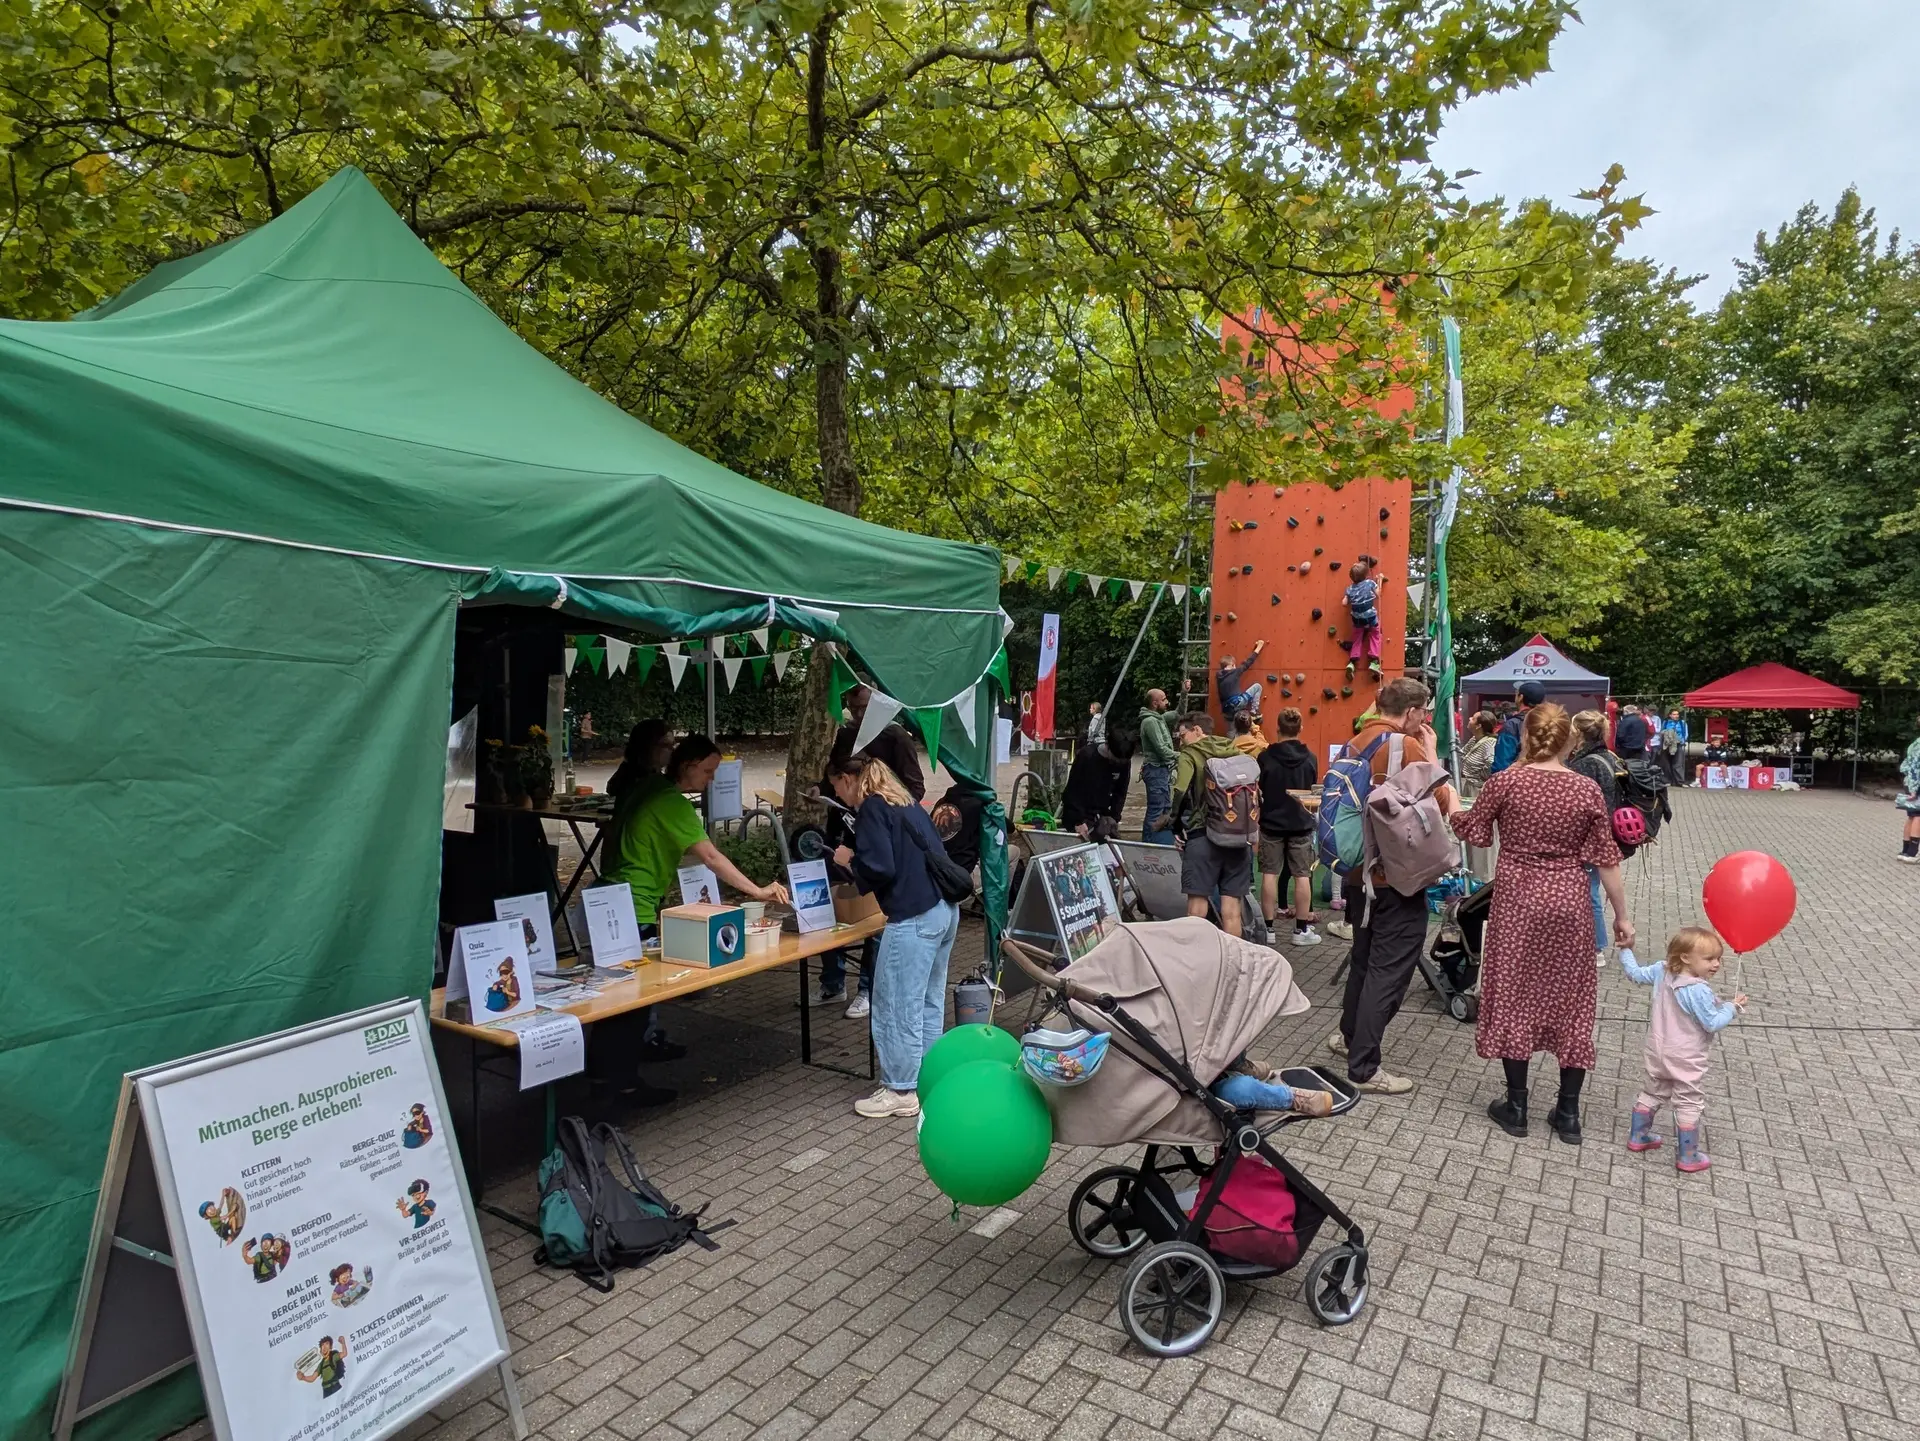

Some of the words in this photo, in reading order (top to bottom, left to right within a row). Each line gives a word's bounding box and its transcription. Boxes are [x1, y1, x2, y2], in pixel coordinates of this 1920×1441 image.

[1060, 907, 1066, 921] 5
[1065, 896, 1101, 919] Startplätze
[1065, 911, 1098, 940] gewinnen!
[468, 940, 485, 951] Quiz
[377, 1020, 405, 1040] DAV
[198, 1101, 295, 1143] Mitmachen.
[298, 1065, 397, 1109] Ausprobieren.
[252, 1118, 298, 1146] Berge
[301, 1093, 363, 1128] erleben!
[339, 1154, 367, 1169] Rätseln,
[367, 1141, 399, 1158] schätzen,
[352, 1129, 396, 1153] BERGE-QUIZ
[241, 1156, 282, 1179] KLETTERN
[243, 1178, 258, 1190] Gut
[258, 1164, 293, 1186] gesichert
[293, 1156, 312, 1169] hoch
[359, 1158, 381, 1172] fühlen
[387, 1149, 400, 1161] und
[369, 1160, 403, 1181] gewinnen!
[246, 1185, 272, 1201] hinaus
[279, 1170, 306, 1187] einfach
[249, 1199, 264, 1212] mal
[265, 1185, 303, 1207] probieren.
[291, 1212, 332, 1237] BERGFOTO
[294, 1235, 311, 1248] Euer
[312, 1213, 356, 1240] Bergmoment
[297, 1247, 310, 1259] mit
[311, 1235, 338, 1253] unserer
[338, 1219, 369, 1239] Fotobox!
[398, 1217, 446, 1247] VR-BERGWELT
[397, 1246, 415, 1260] Brille
[416, 1238, 427, 1251] auf
[428, 1232, 440, 1245] und
[441, 1229, 450, 1238] ab
[413, 1256, 421, 1264] in
[421, 1250, 432, 1261] die
[432, 1239, 453, 1255] Berge!
[286, 1283, 305, 1298] MAL
[305, 1274, 320, 1288] DIE
[268, 1304, 314, 1336] Ausmalspaß
[314, 1299, 326, 1311] für
[271, 1298, 299, 1320] BERGE
[299, 1286, 322, 1305] BUNT
[349, 1333, 356, 1343] 5
[356, 1315, 387, 1339] TICKETS
[386, 1293, 424, 1321] GEWINNEN
[268, 1330, 293, 1348] kleine
[293, 1311, 329, 1335] Bergfans.
[353, 1326, 391, 1353] Mitmachen
[391, 1317, 405, 1330] und
[405, 1308, 422, 1322] beim
[422, 1293, 450, 1312] Münster-
[356, 1344, 382, 1365] Marsch
[382, 1334, 398, 1349] 2027
[399, 1322, 416, 1339] dabei
[416, 1313, 432, 1328] sein!
[303, 1420, 319, 1435] über
[319, 1407, 340, 1424] 9.000
[340, 1376, 388, 1411] Bergbegeisterte
[393, 1356, 421, 1377] entdecke,
[420, 1348, 432, 1359] was
[431, 1342, 442, 1352] uns
[325, 1420, 340, 1433] was
[340, 1414, 349, 1423] du
[348, 1402, 366, 1418] beim
[365, 1393, 378, 1406] DAV
[378, 1377, 404, 1397] Münster
[403, 1364, 425, 1381] erleben
[350, 1427, 362, 1440] die
[362, 1411, 386, 1432] Berge!
[385, 1366, 456, 1415] www.dav-muenster.de
